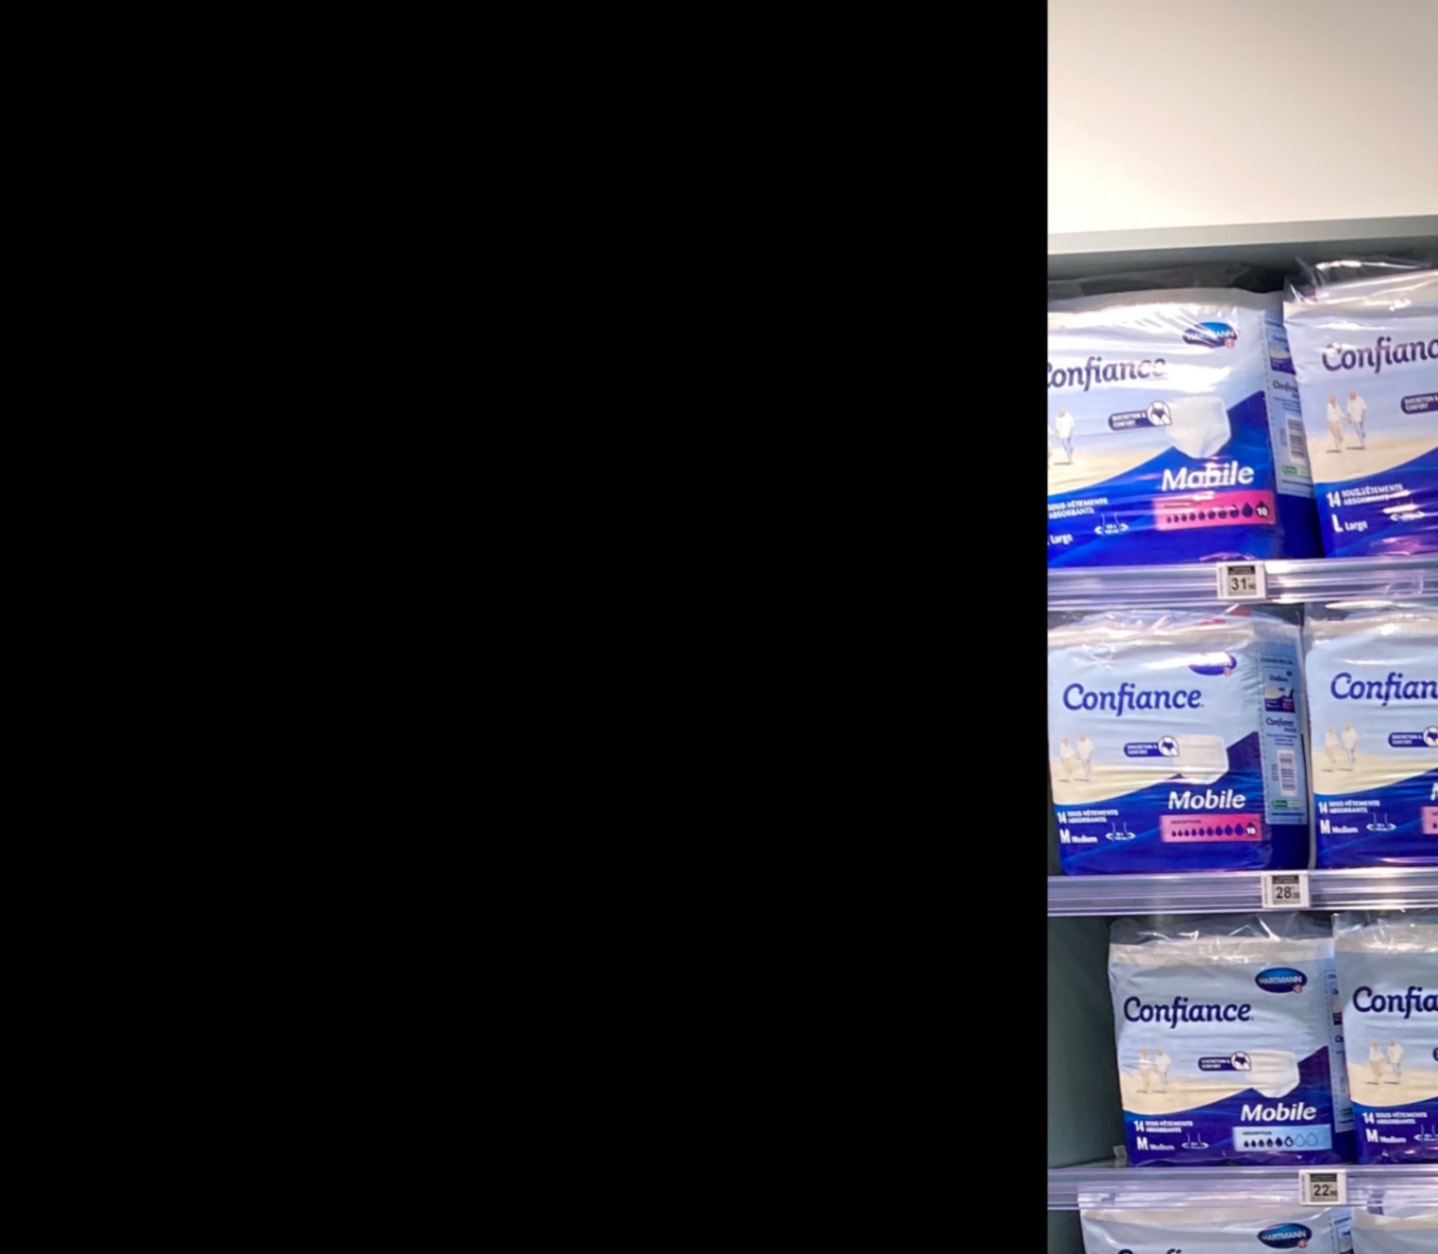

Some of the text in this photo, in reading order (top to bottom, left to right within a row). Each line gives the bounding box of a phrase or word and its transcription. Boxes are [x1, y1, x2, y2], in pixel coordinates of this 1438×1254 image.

[1161, 460, 1255, 492] Mobile
[1326, 490, 1341, 508] 14
[1332, 514, 1344, 533] L
[1231, 577, 1247, 591] 31
[1063, 682, 1202, 716] Confiance
[1168, 789, 1246, 810] Mobile
[1320, 819, 1331, 834] M
[1060, 828, 1071, 844] M
[1275, 886, 1291, 900] 28
[1124, 996, 1252, 1029] Confiance
[1240, 1102, 1316, 1122] Mobile
[1136, 1136, 1149, 1150] M
[1366, 1129, 1379, 1143] M
[1313, 1184, 1329, 1197] 22
